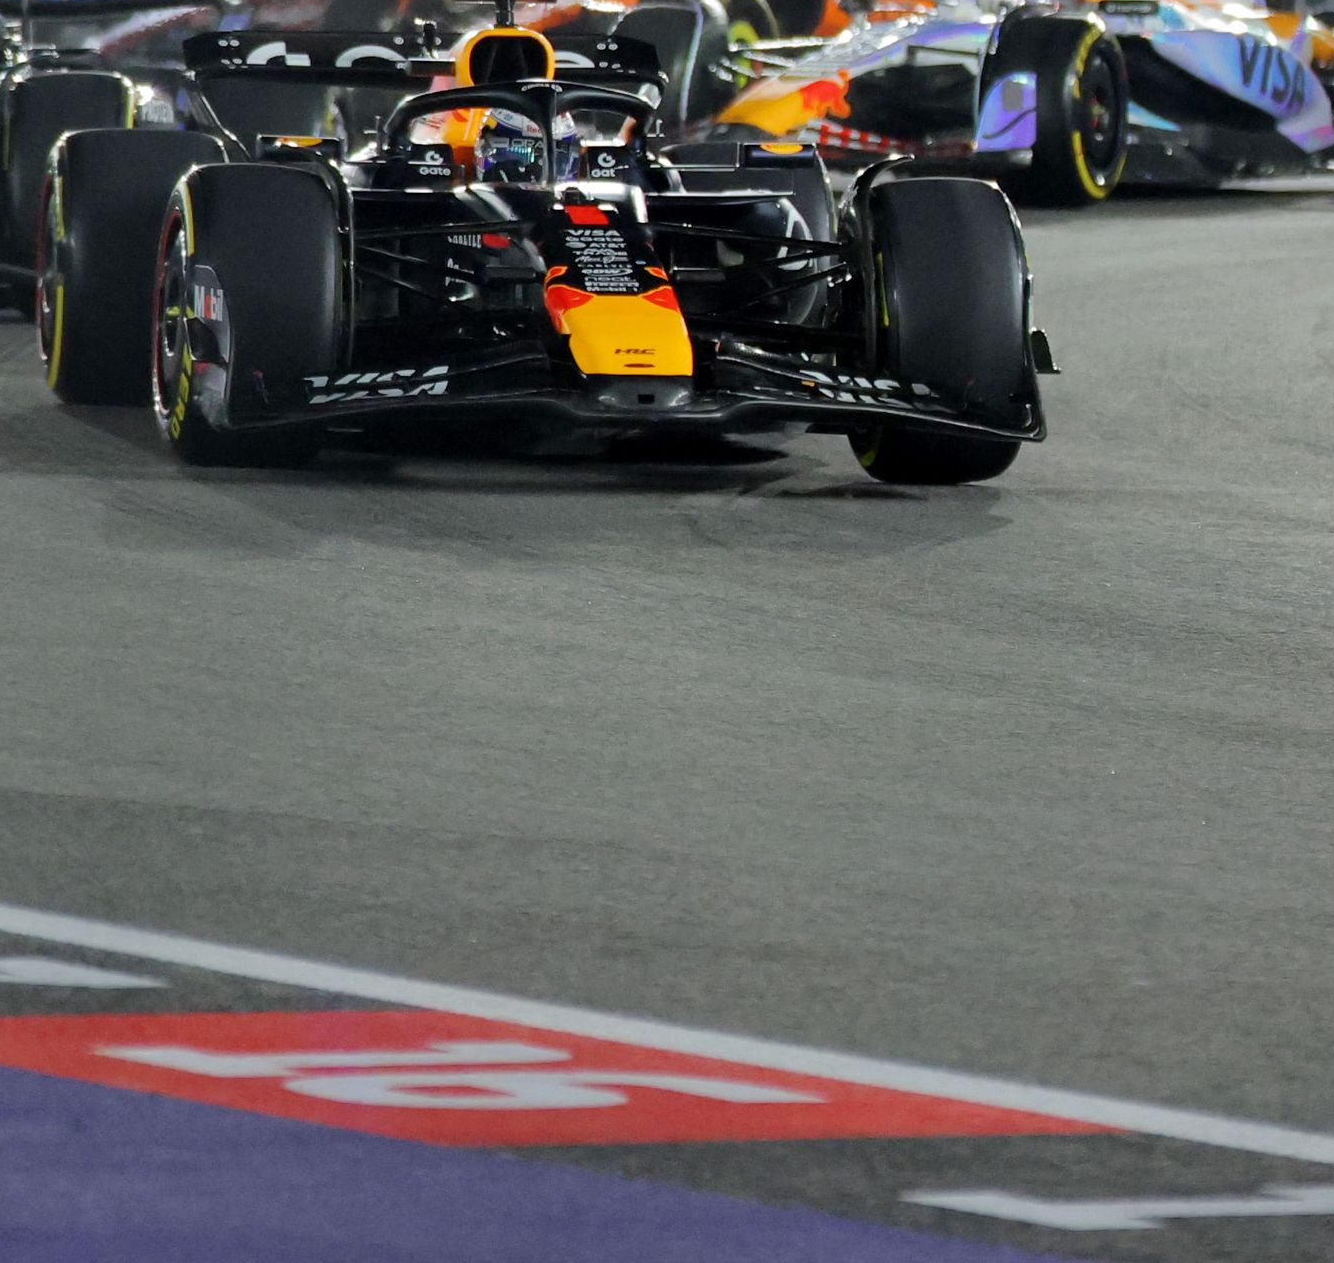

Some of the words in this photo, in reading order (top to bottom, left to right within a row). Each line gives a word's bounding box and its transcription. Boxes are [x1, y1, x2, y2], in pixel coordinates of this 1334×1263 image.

[1238, 36, 1306, 111] VISA
[419, 167, 452, 177] Gate
[592, 168, 616, 178] Gat
[303, 365, 450, 405] VISA
[94, 1041, 830, 1110] 16
